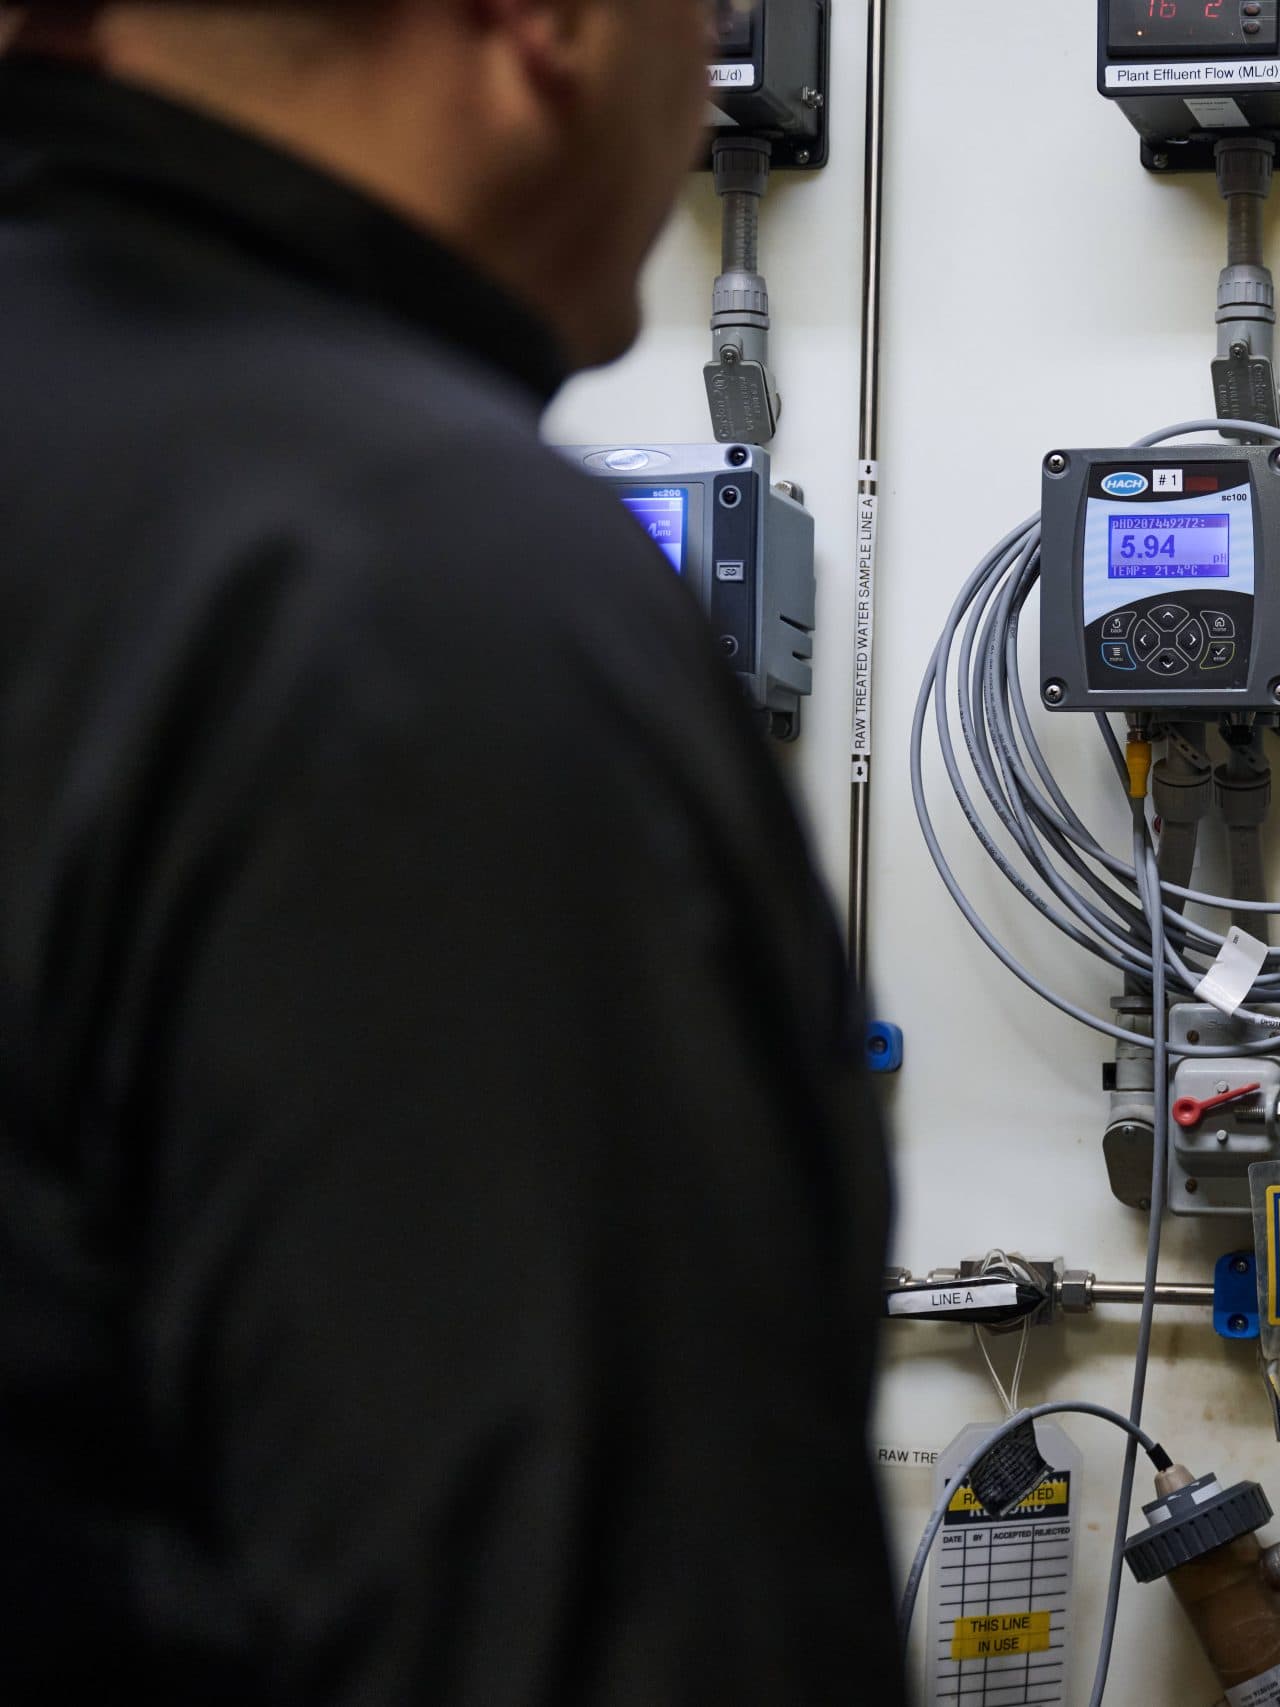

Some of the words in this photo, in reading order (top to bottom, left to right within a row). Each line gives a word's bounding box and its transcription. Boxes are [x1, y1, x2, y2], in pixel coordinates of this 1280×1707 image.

[1117, 70, 1149, 82] Plant
[1153, 68, 1202, 81] Effluent
[1205, 67, 1234, 79] Flow
[1238, 65, 1279, 79] (ML/d)
[1106, 479, 1143, 489] HACH
[652, 489, 681, 497] sc200
[1221, 493, 1247, 502] sc100
[862, 498, 873, 508] A
[860, 511, 873, 540] LINE
[1120, 534, 1176, 559] 5.94
[1213, 553, 1227, 563] pH
[858, 544, 872, 598] SAMPLE
[1112, 565, 1147, 576] TEMP:
[857, 601, 870, 649] WATER
[856, 652, 868, 715] TREATED
[854, 718, 866, 749] RAW
[931, 1292, 962, 1306] LINE
[964, 1291, 974, 1304] A
[879, 1449, 909, 1462] RAW
[943, 1535, 962, 1544] DATE
[973, 1534, 983, 1542] BY
[993, 1529, 1032, 1540] ACCEPTED
[1034, 1527, 1070, 1537] REJECTED
[970, 1619, 999, 1633] THIS
[1002, 1616, 1030, 1630] LINE
[978, 1640, 990, 1653] IN
[993, 1637, 1020, 1651] USE
